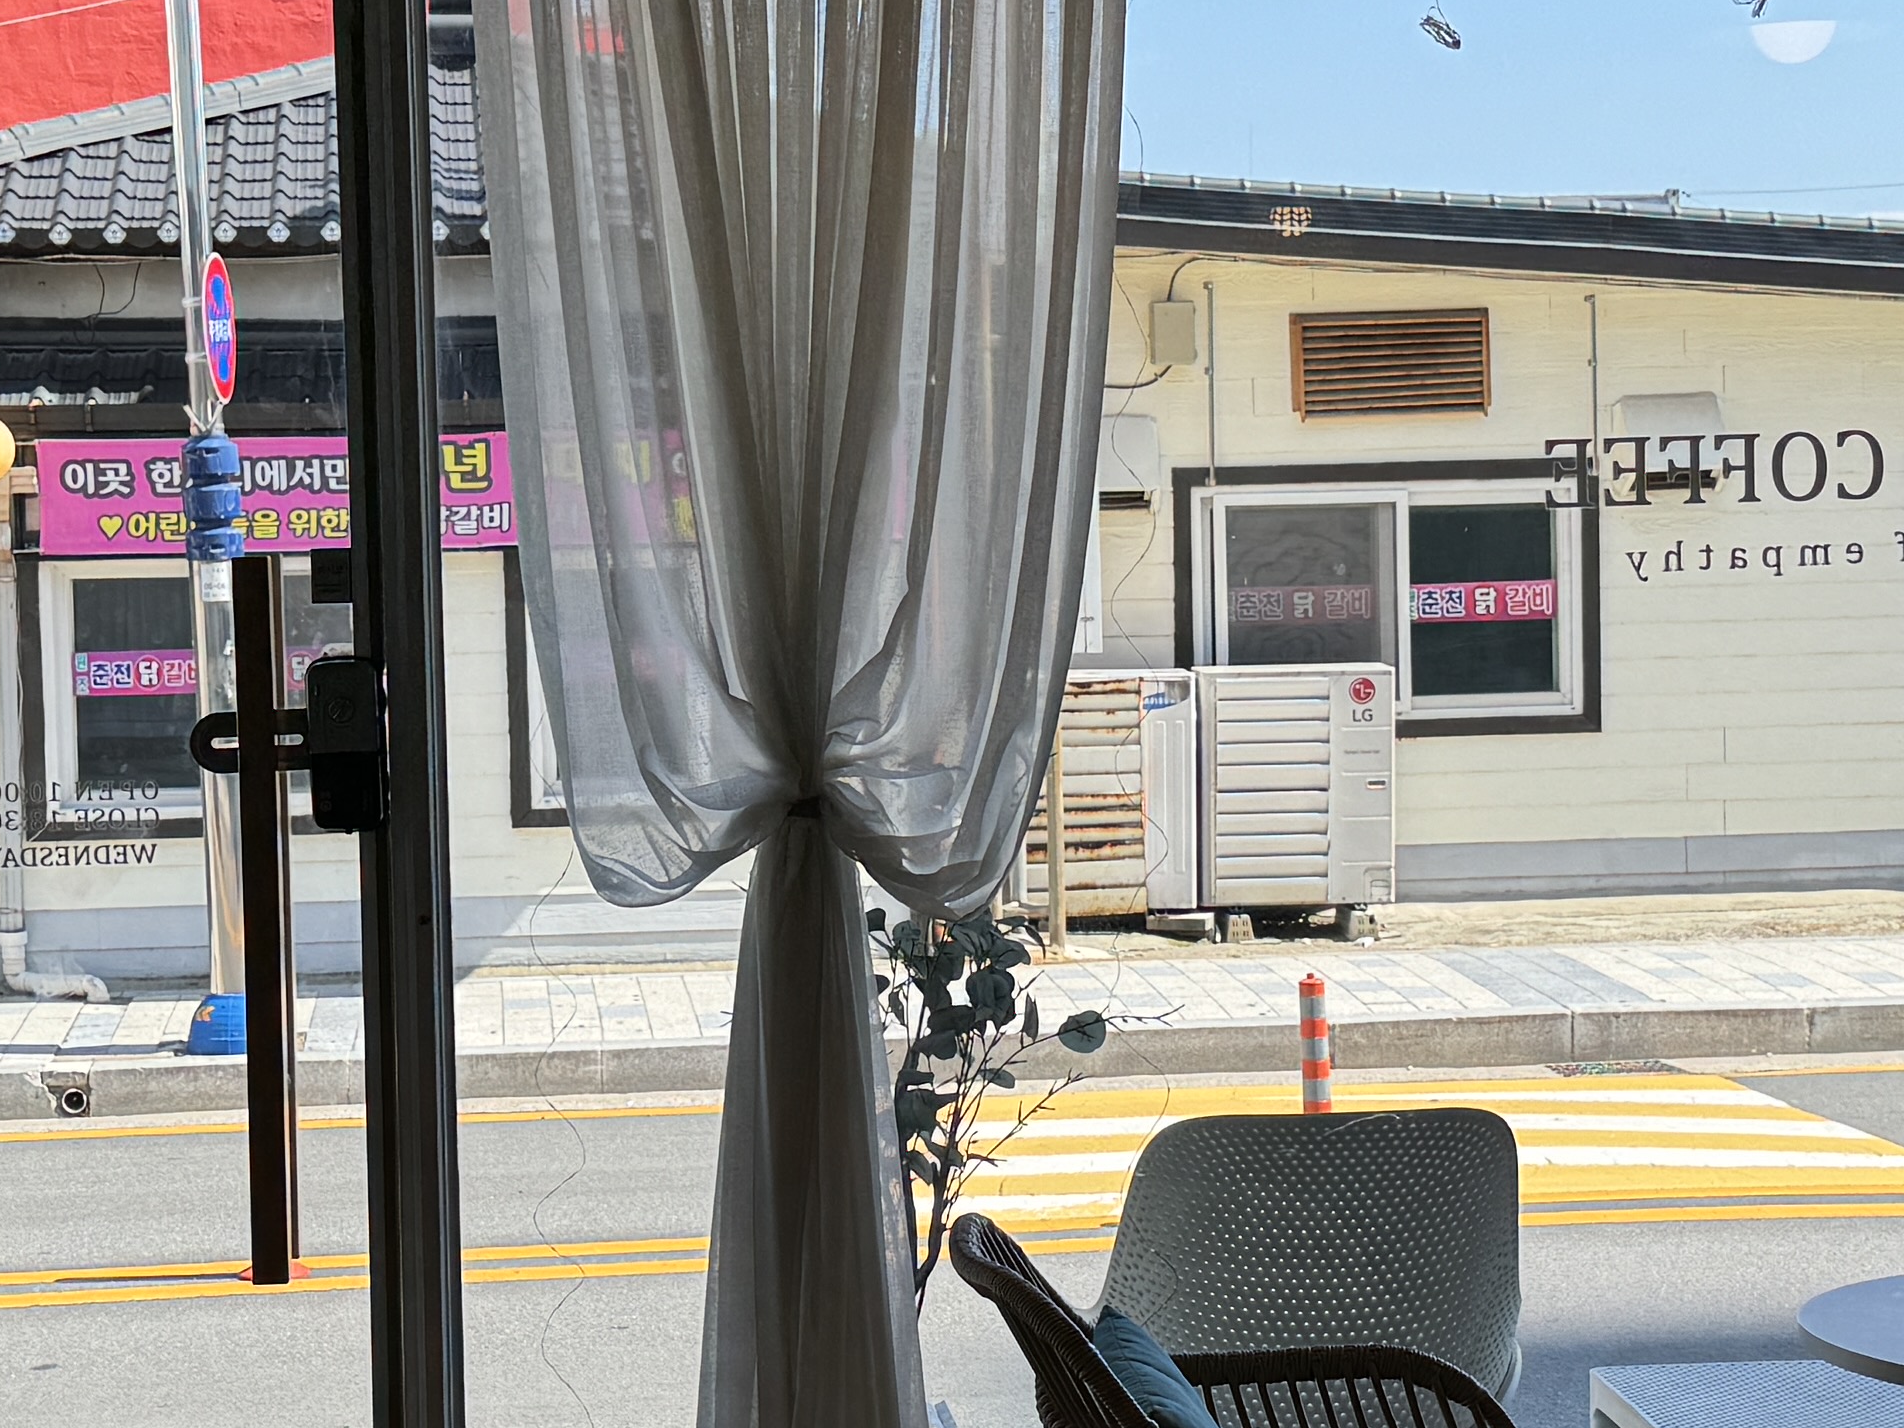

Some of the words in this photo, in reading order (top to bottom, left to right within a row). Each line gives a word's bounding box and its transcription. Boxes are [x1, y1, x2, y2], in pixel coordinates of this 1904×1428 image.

[63, 461, 132, 495] 이곳
[289, 507, 349, 539] 위한
[1506, 584, 1553, 616] 갈비
[1352, 708, 1374, 723] LG
